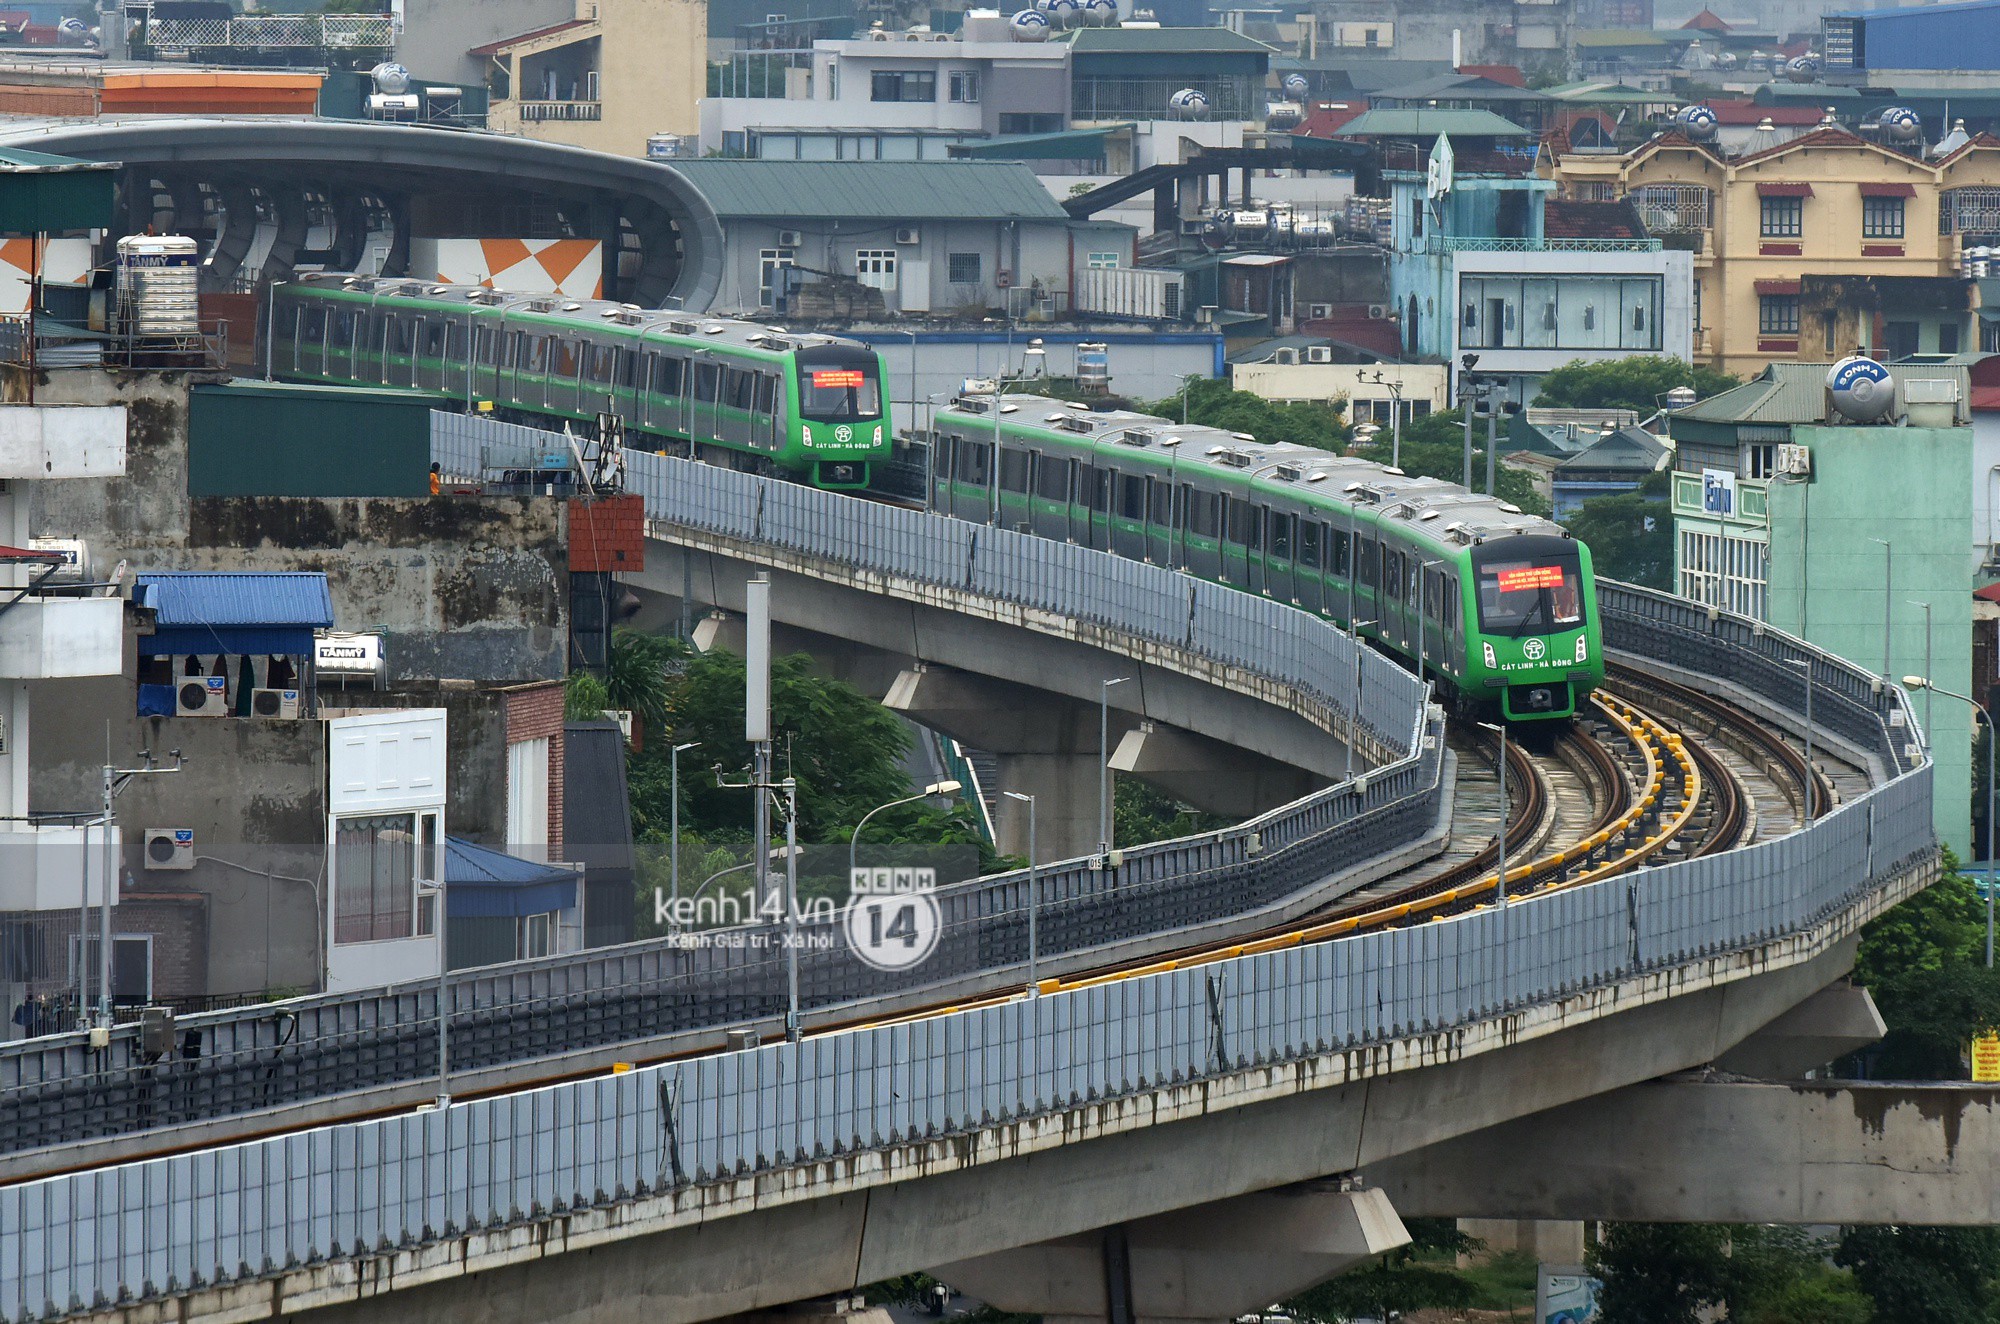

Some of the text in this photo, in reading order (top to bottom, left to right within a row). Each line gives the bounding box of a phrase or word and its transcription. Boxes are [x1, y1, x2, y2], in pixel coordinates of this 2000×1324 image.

[1839, 364, 1879, 387] SONHA
[1501, 662, 1516, 671] CÁT
[1517, 662, 1533, 670] LINH
[1539, 660, 1549, 668] HÀ
[1552, 658, 1572, 667] ĐÔNG
[1090, 859, 1102, 868] 015
